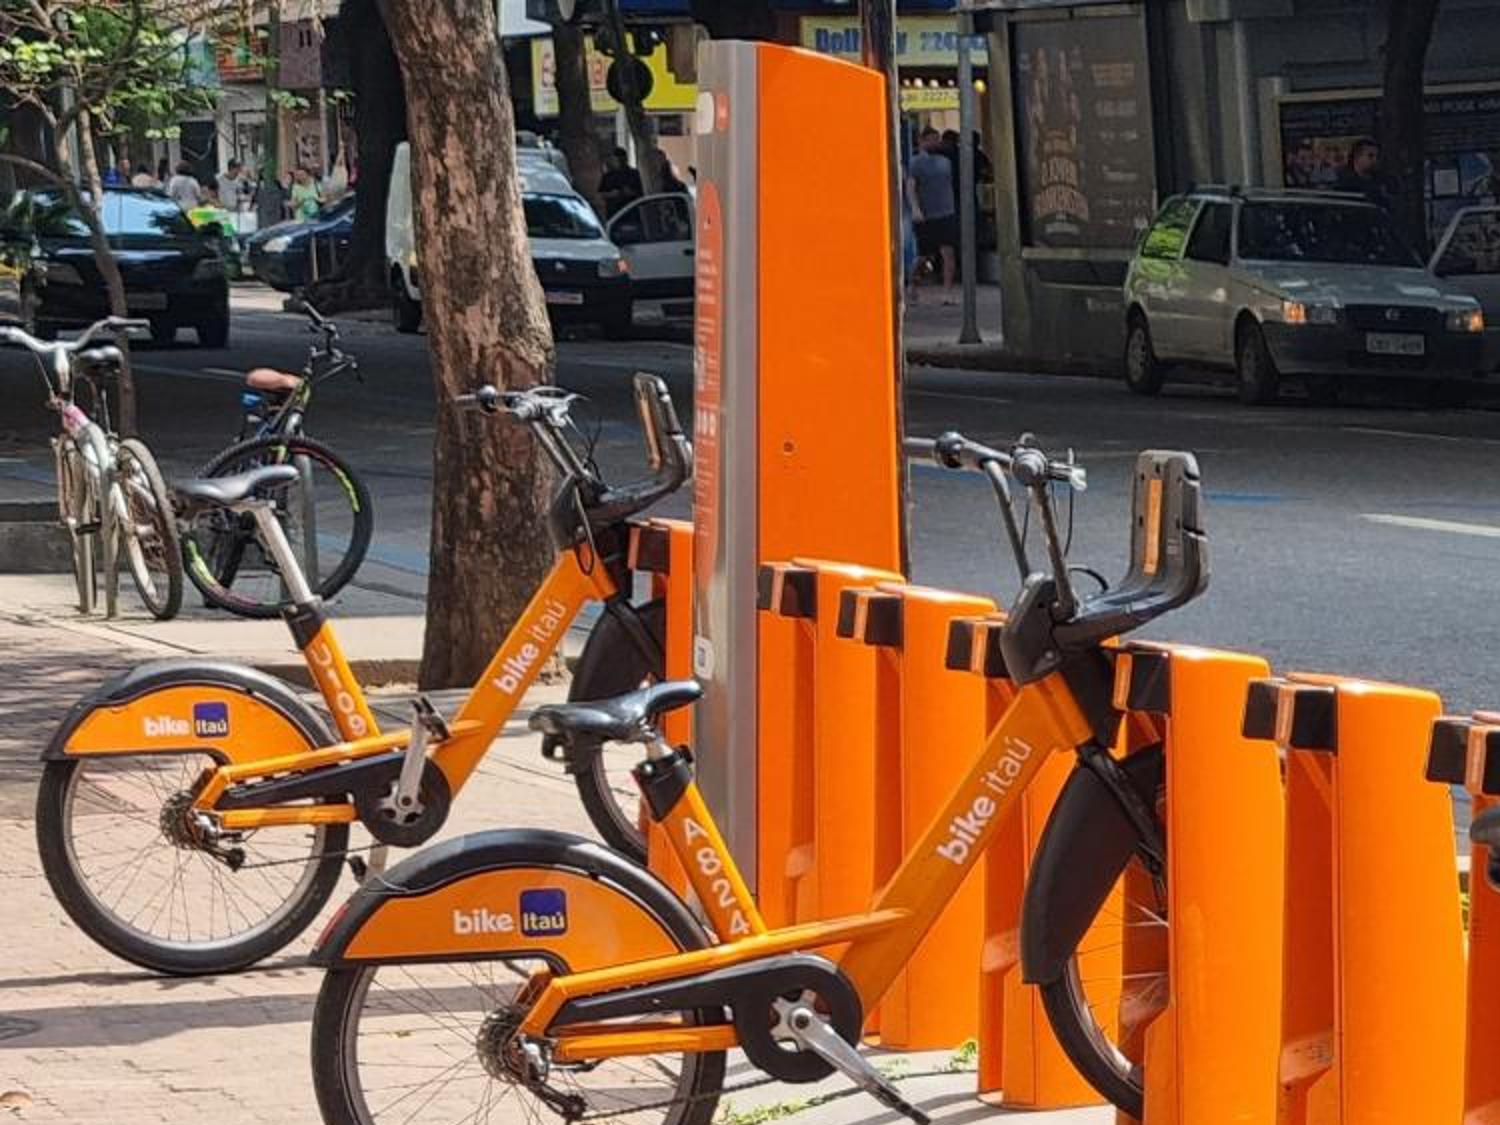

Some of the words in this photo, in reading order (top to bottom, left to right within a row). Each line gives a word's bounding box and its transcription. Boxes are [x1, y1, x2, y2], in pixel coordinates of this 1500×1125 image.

[493, 642, 539, 694] bike
[528, 599, 567, 642] itaú
[142, 715, 190, 737] bike
[195, 718, 228, 735] Itaú
[936, 796, 996, 865] bike
[979, 736, 1033, 795] itaú
[453, 907, 514, 934] bike
[522, 910, 565, 931] Itaú
[684, 817, 751, 934] A824
